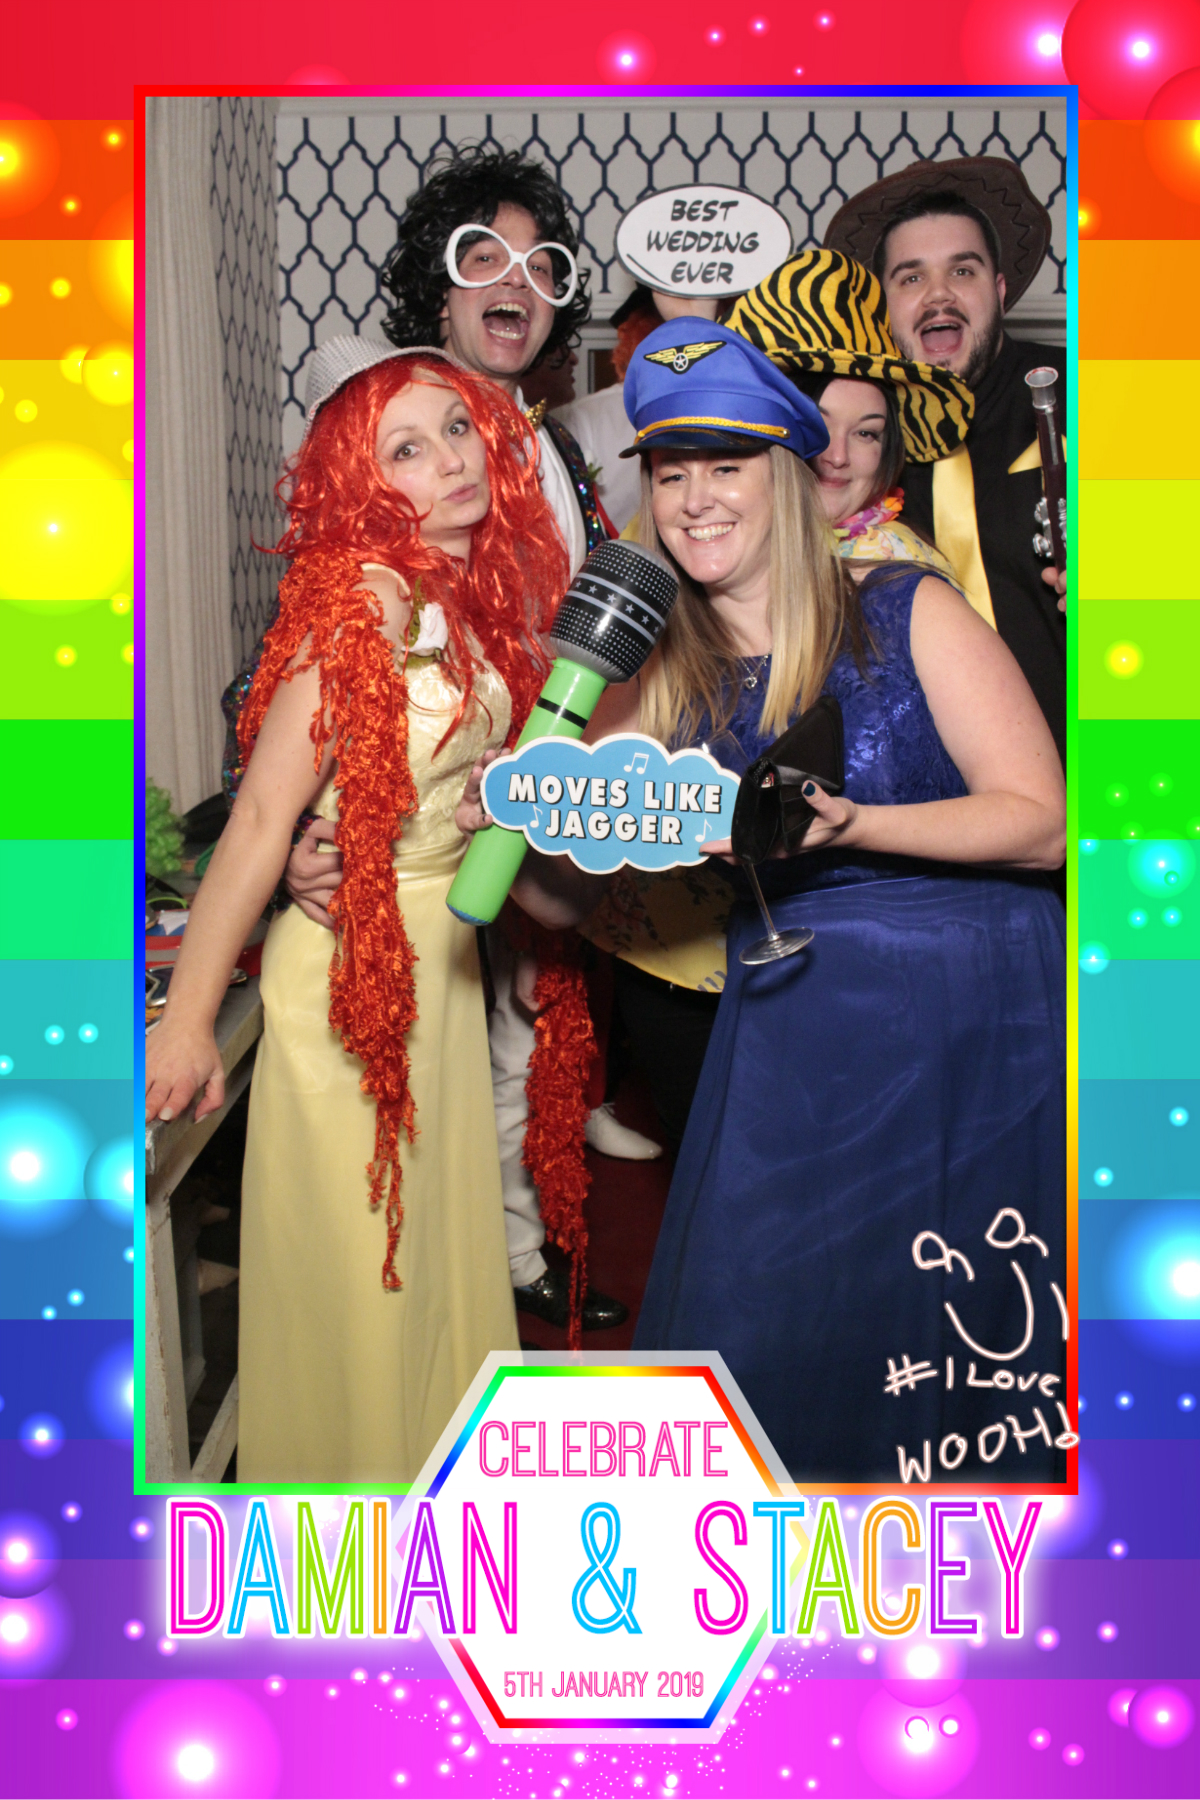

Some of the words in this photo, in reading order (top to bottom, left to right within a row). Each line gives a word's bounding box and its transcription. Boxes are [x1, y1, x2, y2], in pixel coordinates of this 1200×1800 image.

[671, 199, 739, 222] BEST
[647, 230, 759, 254] WEDDING
[671, 261, 734, 285] EVER
[508, 773, 628, 808] MOVES
[643, 781, 721, 814] LIKE
[545, 809, 682, 845] JAGGER
